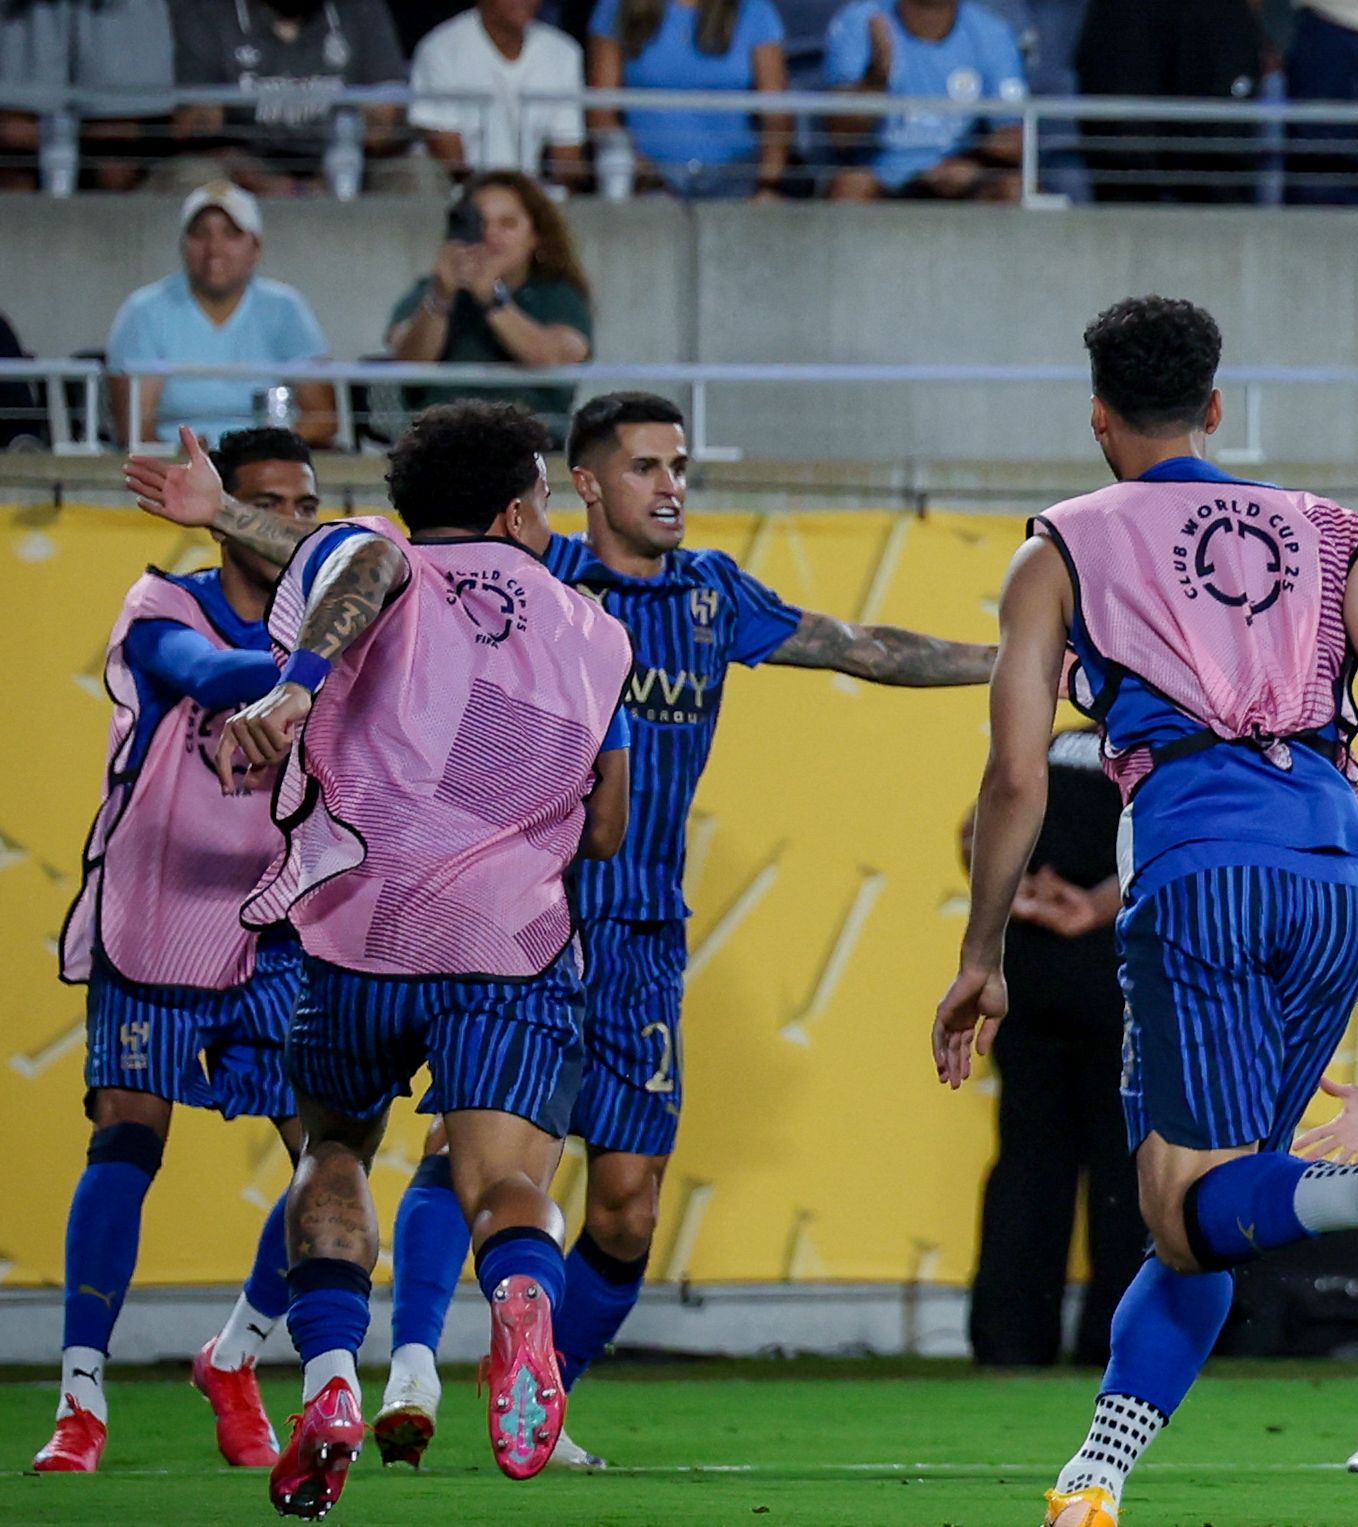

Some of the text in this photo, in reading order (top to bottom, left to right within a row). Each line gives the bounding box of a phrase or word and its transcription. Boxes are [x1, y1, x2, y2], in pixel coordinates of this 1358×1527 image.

[1173, 499, 1299, 599] CLUB WORLD CUP 25
[507, 579, 526, 608] CUP
[624, 667, 708, 708] VVY
[640, 1021, 684, 1093] 2
